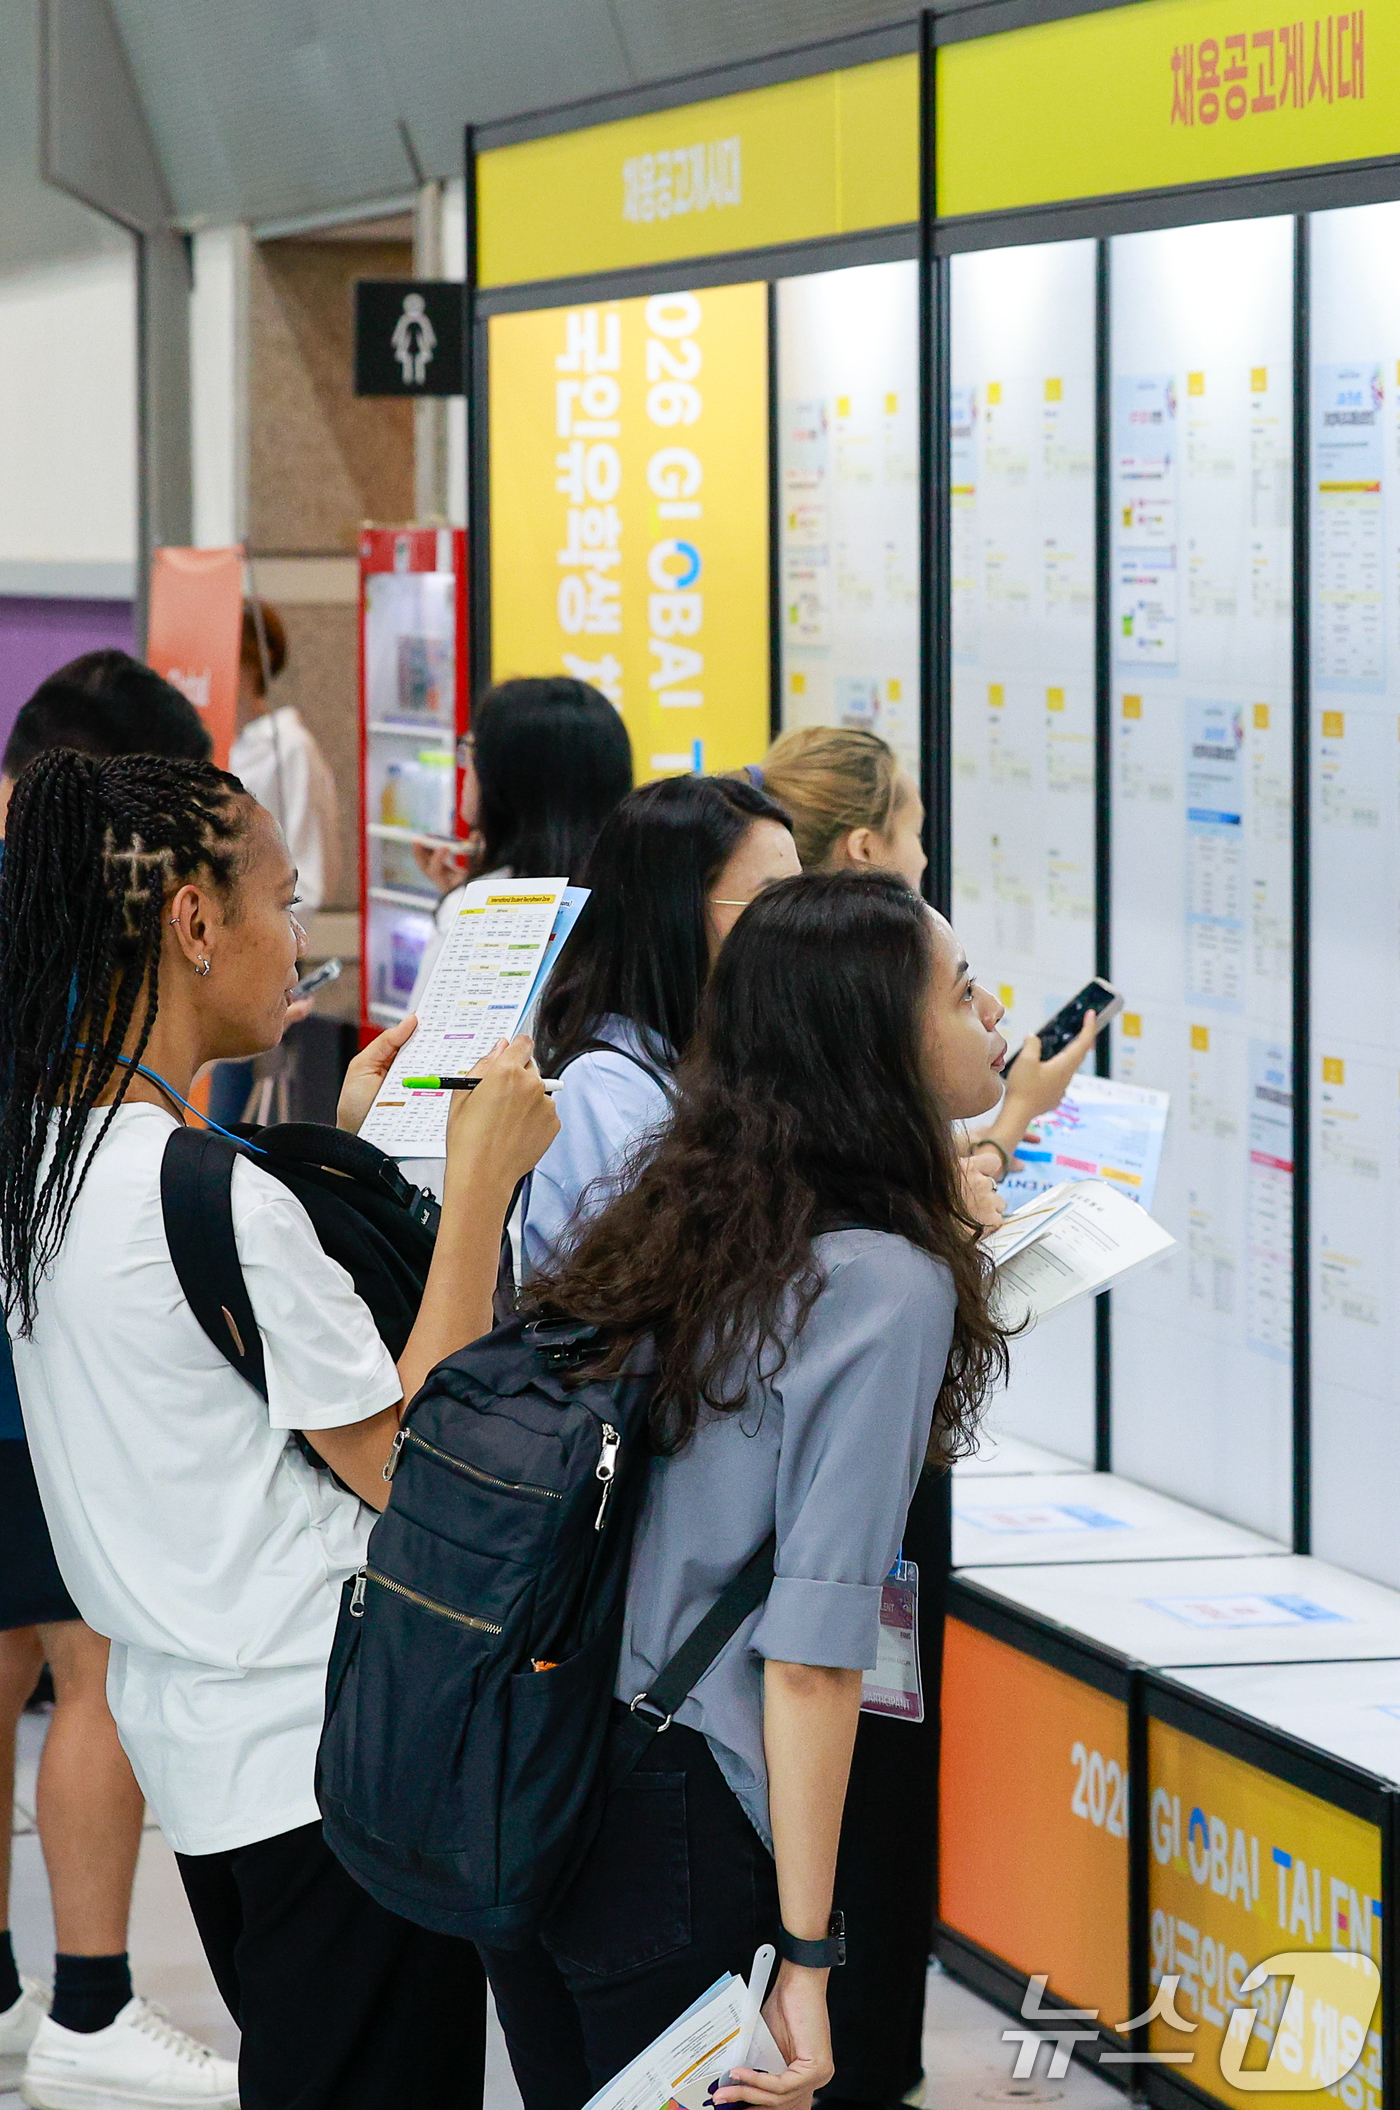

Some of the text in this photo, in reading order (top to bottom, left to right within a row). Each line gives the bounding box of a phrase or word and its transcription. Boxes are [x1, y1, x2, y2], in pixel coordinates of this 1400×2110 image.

[1171, 9, 1365, 126] 채용공고게시대
[555, 300, 623, 636] 국인유학생
[646, 446, 703, 727] GLOBAL
[863, 1689, 911, 1711] PARTICIPANT
[1071, 1741, 1130, 1838] 202
[1150, 1786, 1267, 1919] GLOBAL
